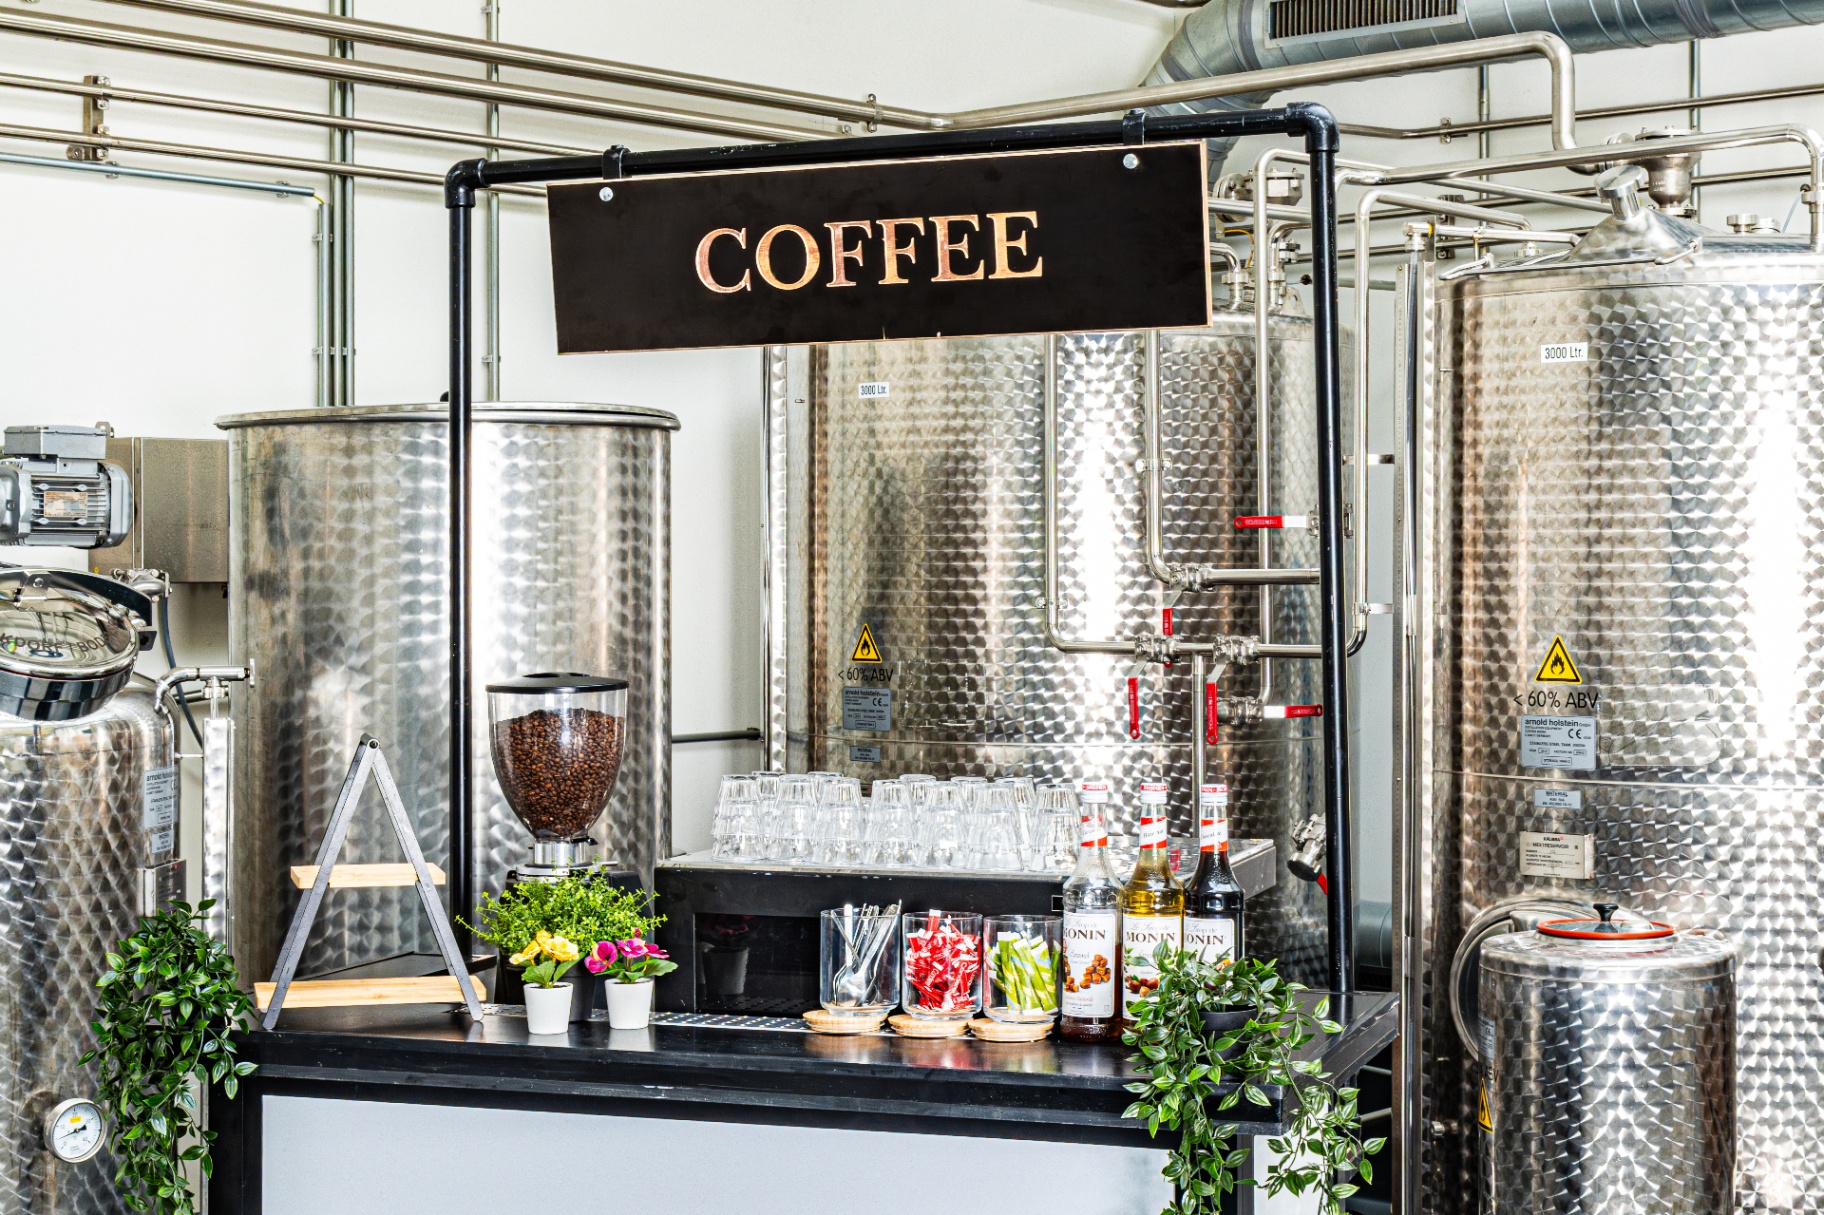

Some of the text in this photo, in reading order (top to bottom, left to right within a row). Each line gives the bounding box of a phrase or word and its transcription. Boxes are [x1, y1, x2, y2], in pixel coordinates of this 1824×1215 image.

[695, 210, 1043, 293] COFFEE
[1544, 346, 1568, 360] 3000
[860, 385, 876, 395] 3000
[846, 667, 869, 682] 60%
[870, 668, 894, 682] ABV
[1527, 690, 1561, 709] 60%
[1565, 692, 1600, 710] ABV
[1524, 718, 1548, 726] arnold
[1548, 718, 1579, 727] holstein
[1126, 931, 1175, 943] MONIN
[1184, 933, 1224, 945] ONIN
